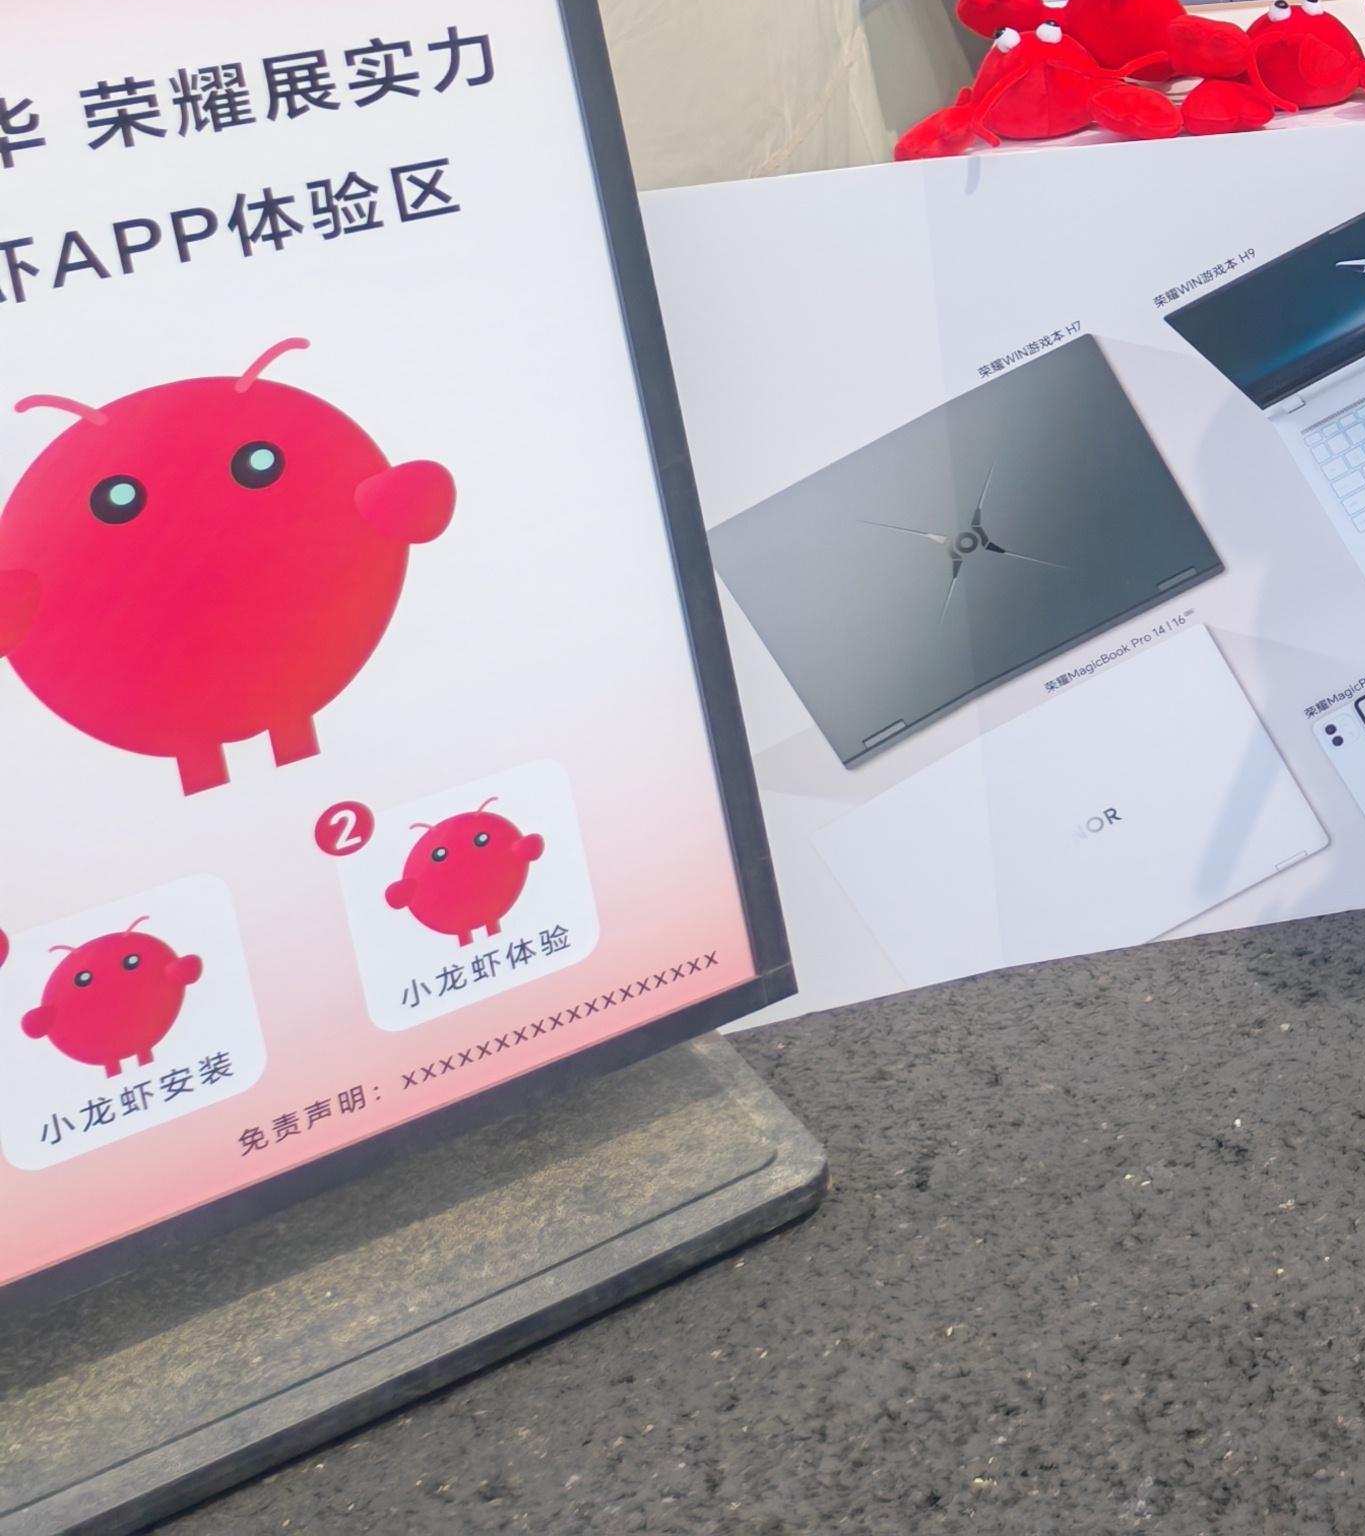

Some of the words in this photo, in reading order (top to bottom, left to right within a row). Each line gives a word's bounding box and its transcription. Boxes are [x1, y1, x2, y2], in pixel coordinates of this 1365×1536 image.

[79, 25, 497, 151] 荣耀展实力
[1238, 248, 1256, 263] H9
[1065, 320, 1081, 335] H7
[1131, 633, 1152, 649] Pro
[1152, 624, 1166, 637] 14
[1172, 615, 1186, 627] 16
[330, 808, 361, 851] 2
[1079, 808, 1123, 836] OR
[401, 924, 572, 1010] 小龙虾体验
[40, 1051, 235, 1147] 小龙虾安装
